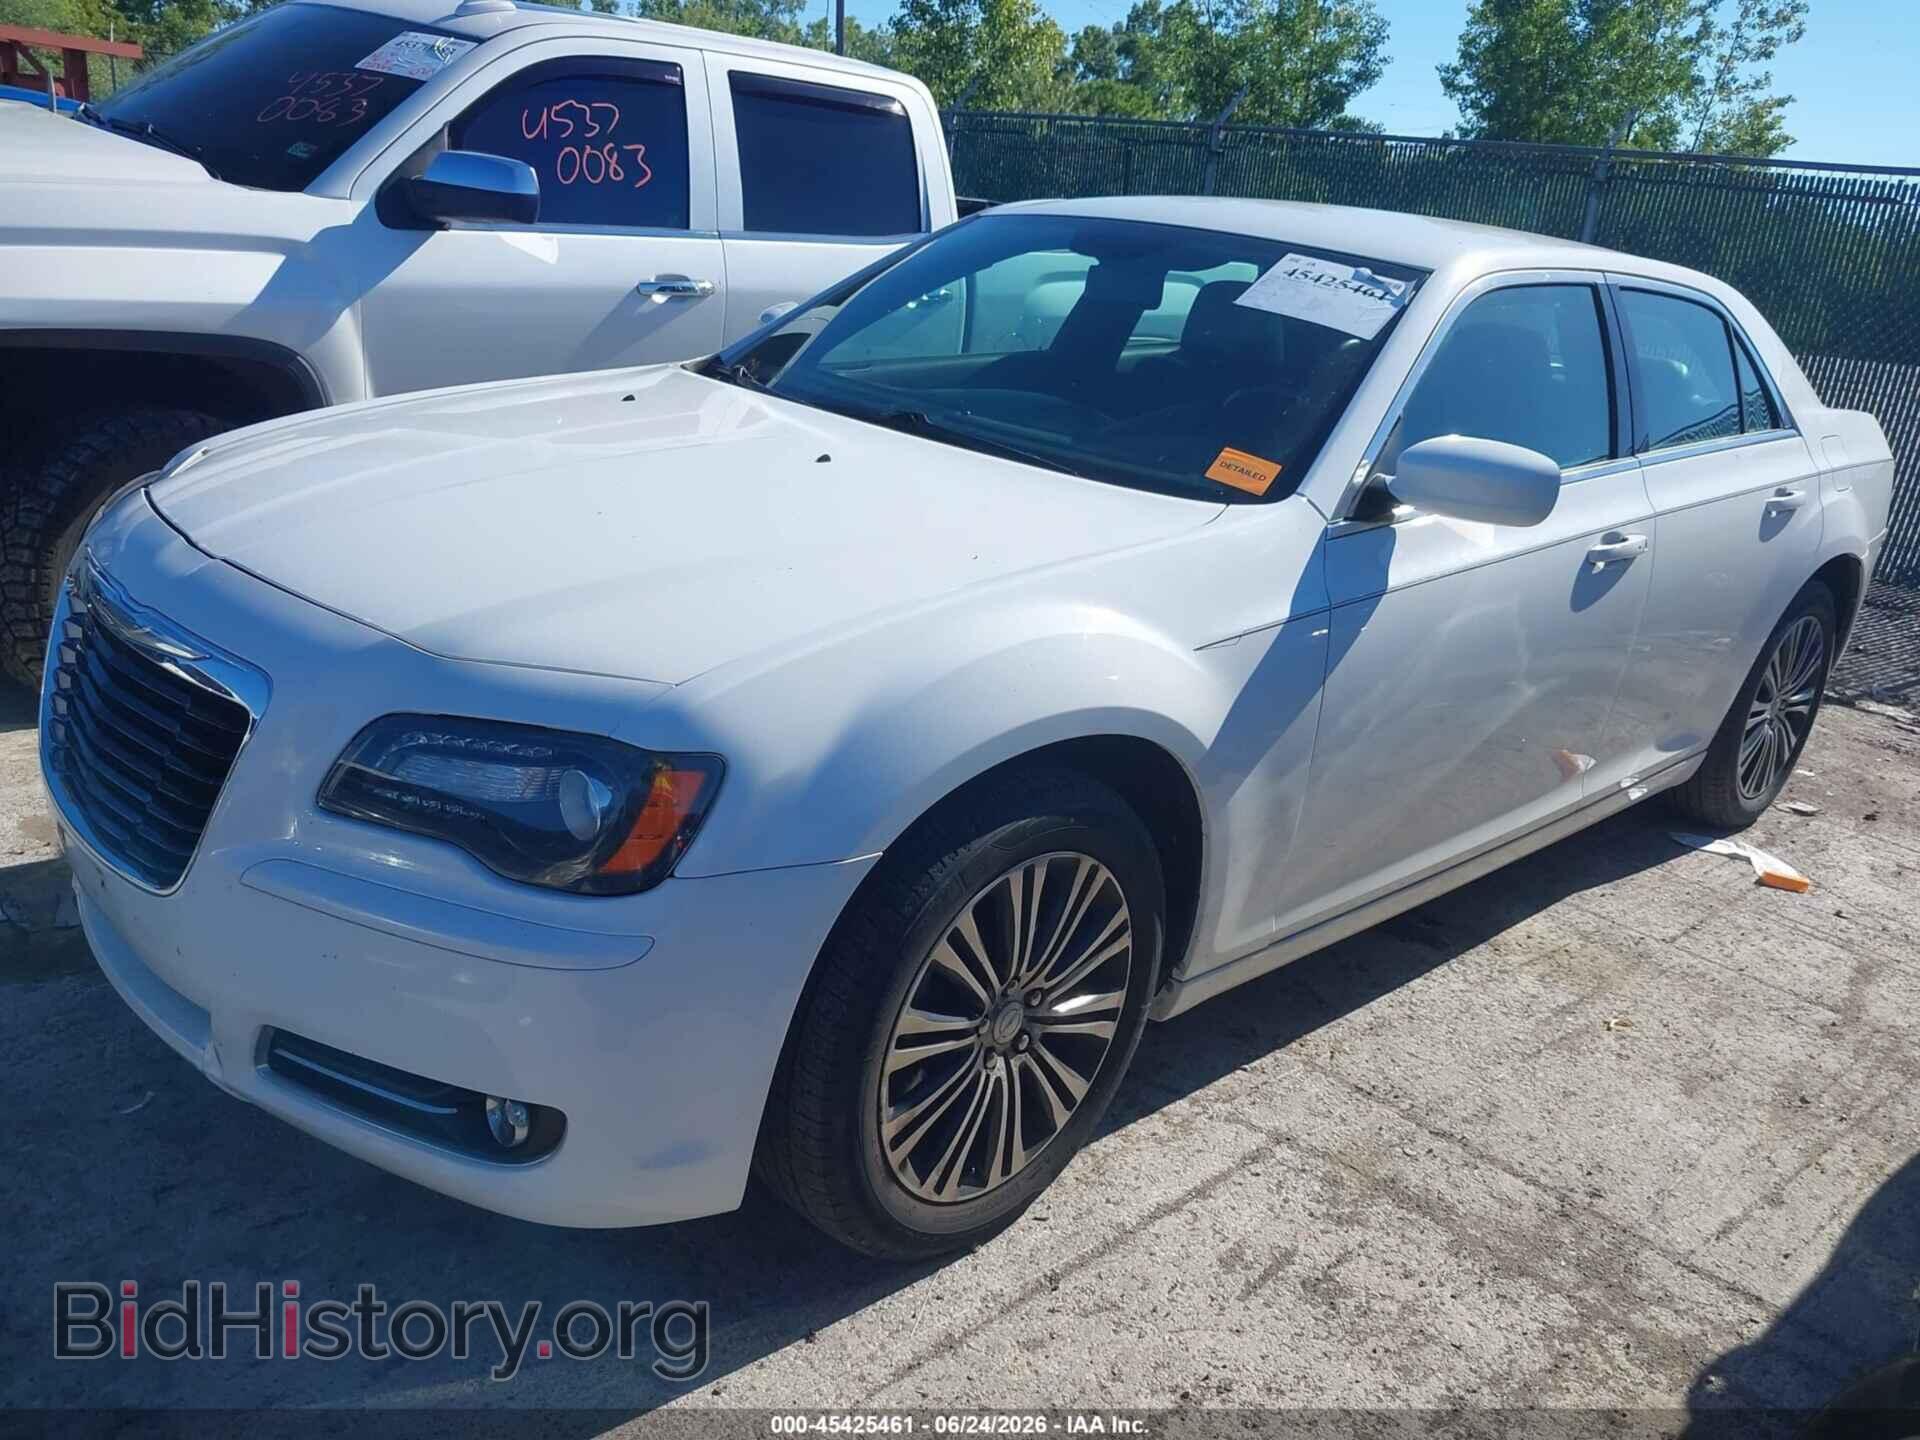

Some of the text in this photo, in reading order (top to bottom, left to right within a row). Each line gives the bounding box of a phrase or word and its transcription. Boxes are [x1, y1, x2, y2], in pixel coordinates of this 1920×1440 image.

[257, 96, 368, 127] 0083
[557, 142, 652, 188] 0083
[1283, 267, 1390, 301] 45425461
[1220, 461, 1267, 480] DETAILED
